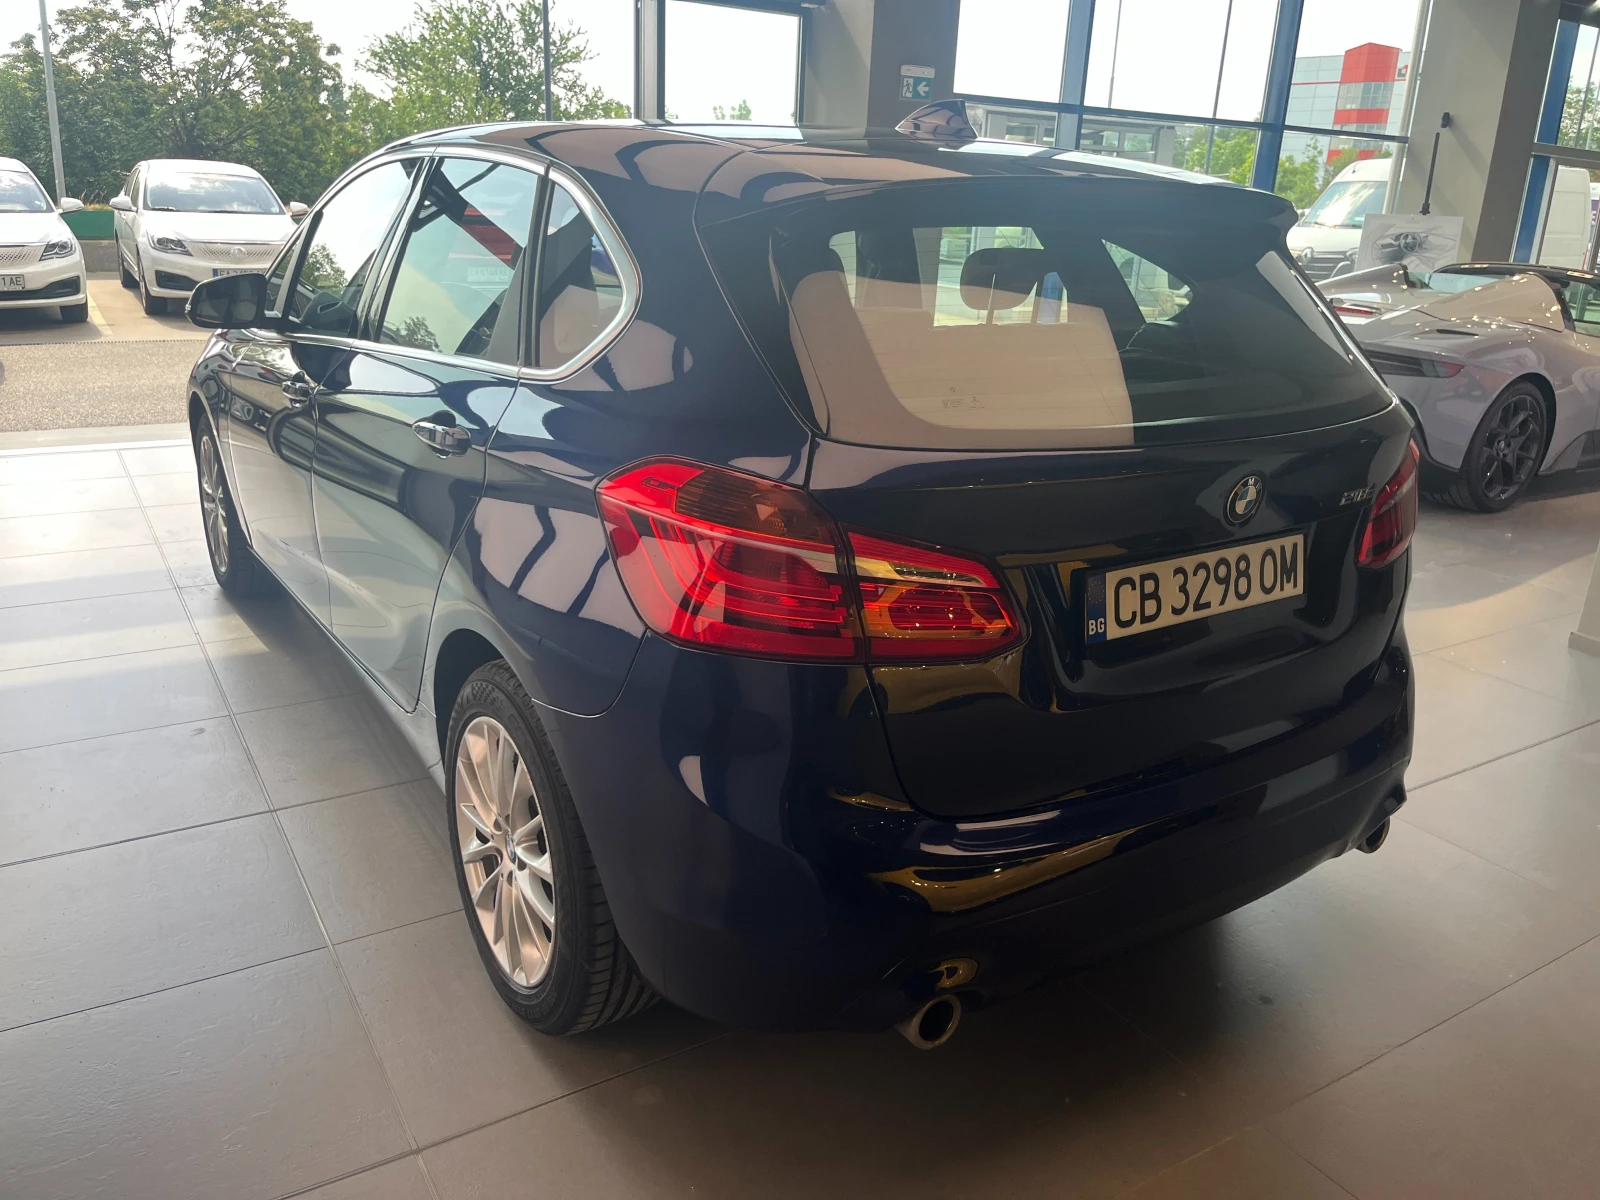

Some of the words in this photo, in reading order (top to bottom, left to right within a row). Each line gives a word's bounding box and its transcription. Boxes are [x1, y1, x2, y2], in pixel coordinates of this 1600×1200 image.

[9, 276, 22, 286] AE
[1114, 573, 1162, 628] CB
[1171, 553, 1252, 615] 3298
[1260, 542, 1298, 595] OM
[1089, 617, 1105, 635] BG
